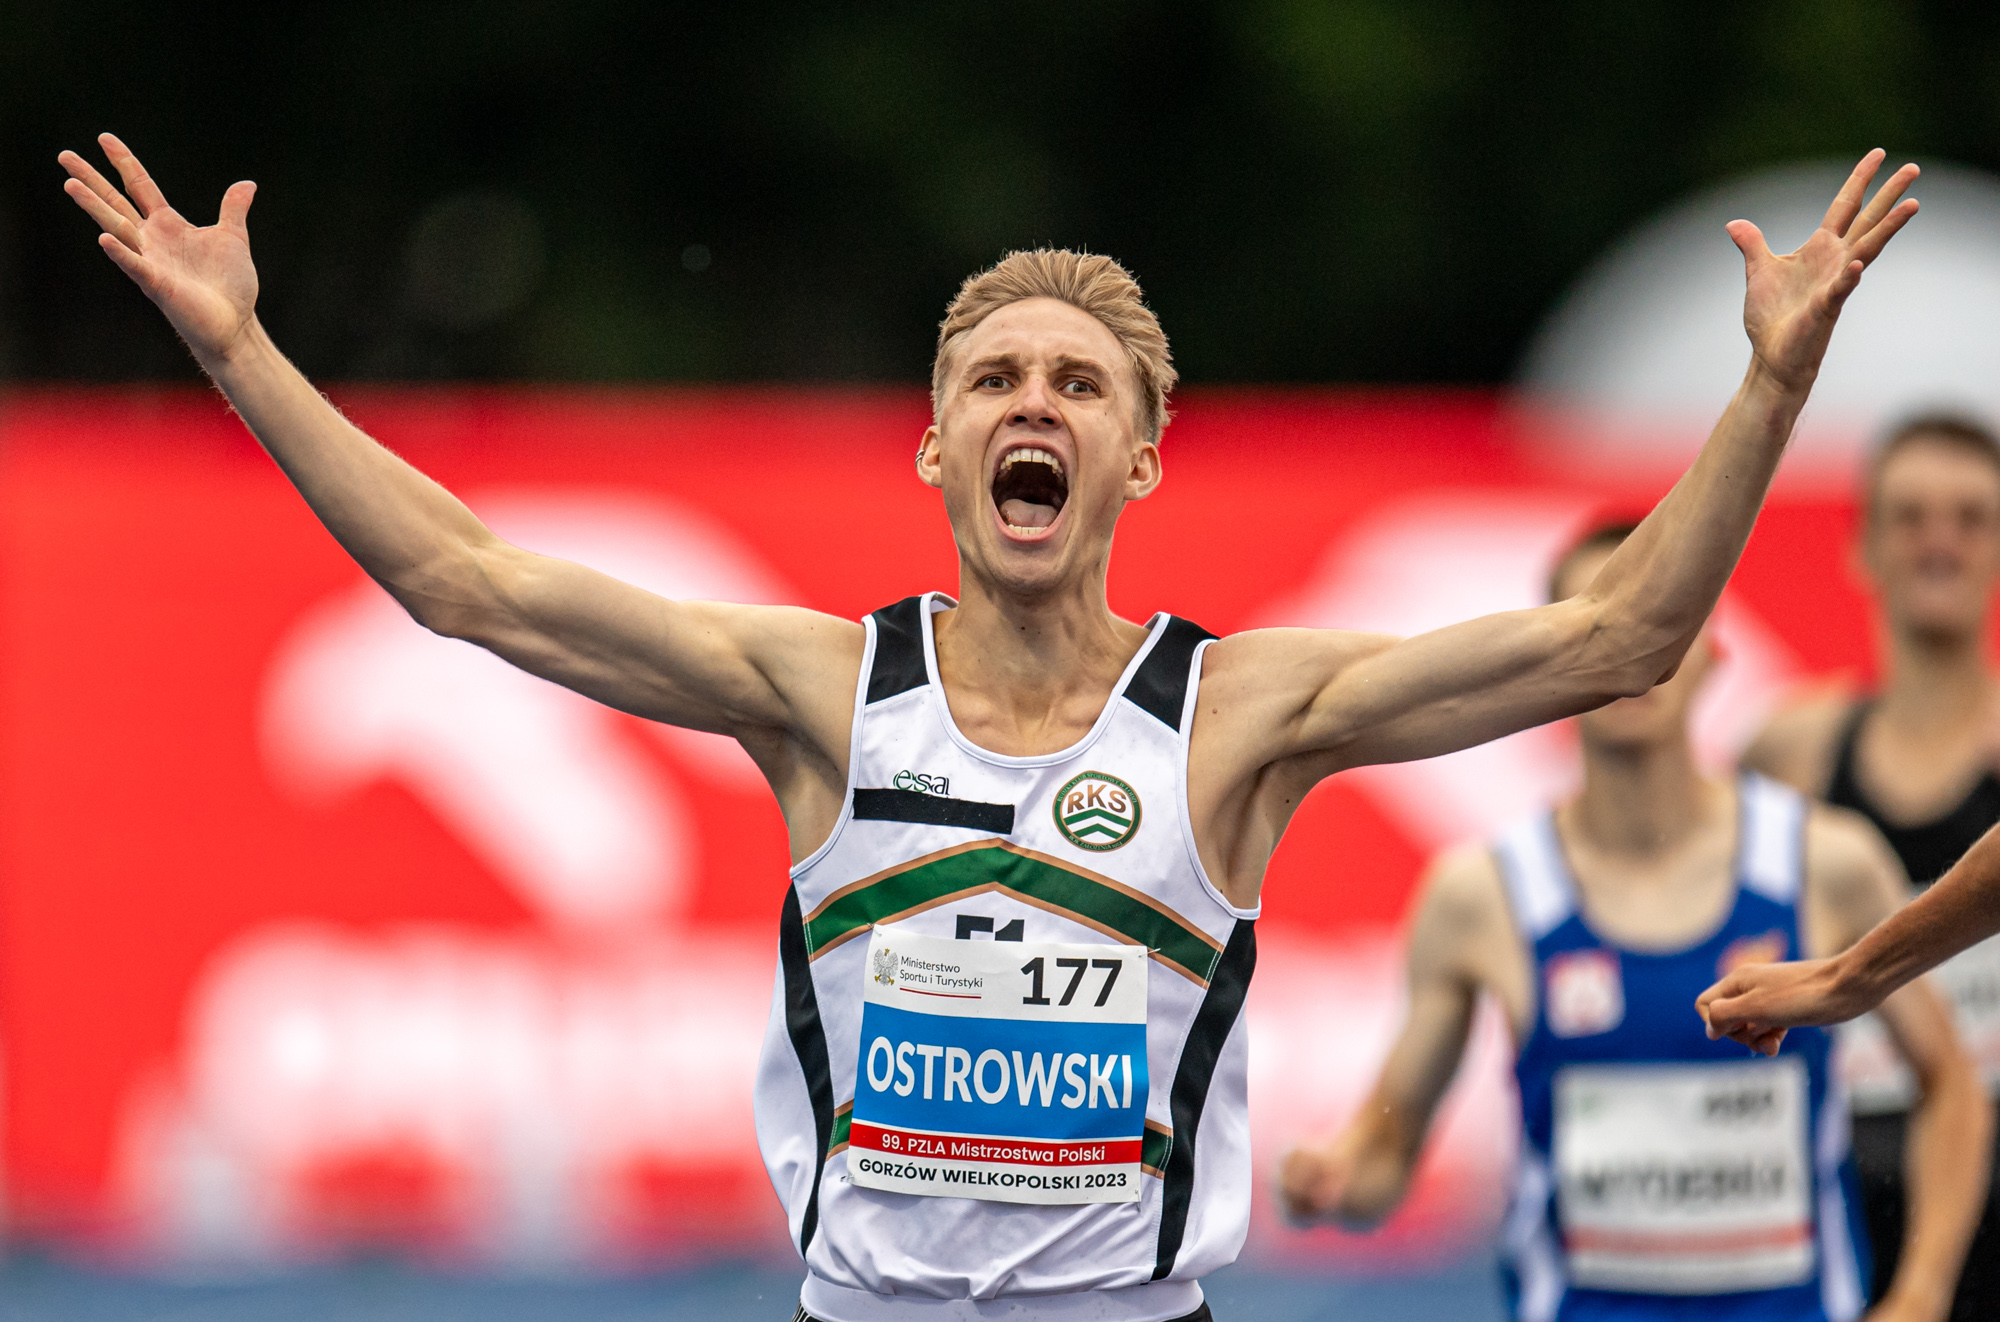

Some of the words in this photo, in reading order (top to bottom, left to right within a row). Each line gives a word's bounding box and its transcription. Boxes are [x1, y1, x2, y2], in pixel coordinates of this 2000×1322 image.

[1067, 784, 1127, 814] RKS
[900, 970, 927, 986] Sportu
[930, 974, 933, 984] i
[936, 975, 983, 989] Turystyki
[901, 956, 960, 973] Ministerstwo
[1020, 957, 1123, 1007] 177
[867, 1036, 1132, 1109] OSTROWSKI
[882, 1134, 903, 1151] 99.
[908, 1139, 946, 1155] PZLA
[951, 1142, 1054, 1162] Mistrzostwa
[1059, 1146, 1105, 1162] Polski
[859, 1158, 937, 1182] GORZÓW
[943, 1169, 1080, 1189] WIELKOPOLSKI
[1084, 1173, 1127, 1188] 2023
